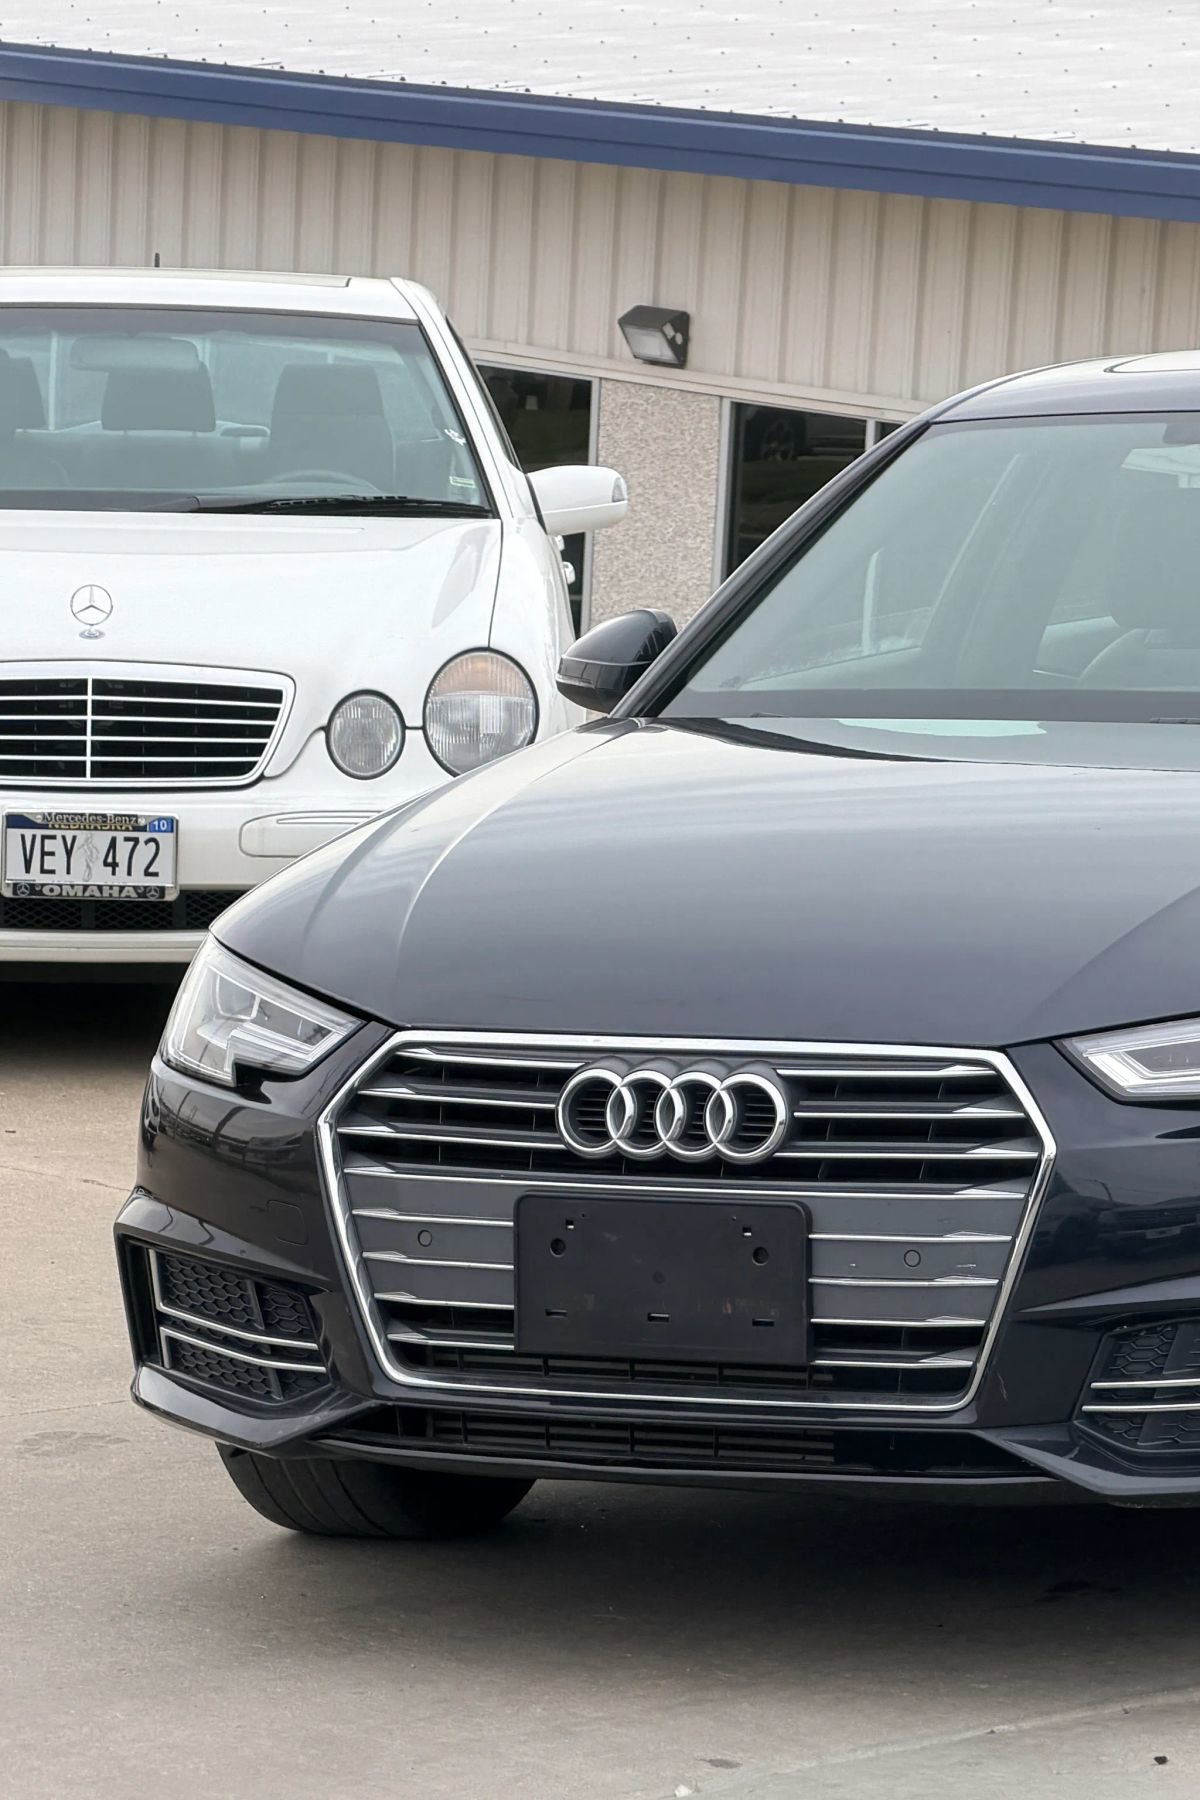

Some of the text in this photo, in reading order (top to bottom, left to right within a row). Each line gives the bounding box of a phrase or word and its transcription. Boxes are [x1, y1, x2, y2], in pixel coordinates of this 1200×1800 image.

[43, 812, 138, 825] Mercedes-Benz
[153, 820, 167, 831] 10
[20, 834, 161, 877] VEY 472
[42, 885, 138, 898] OMAHA
